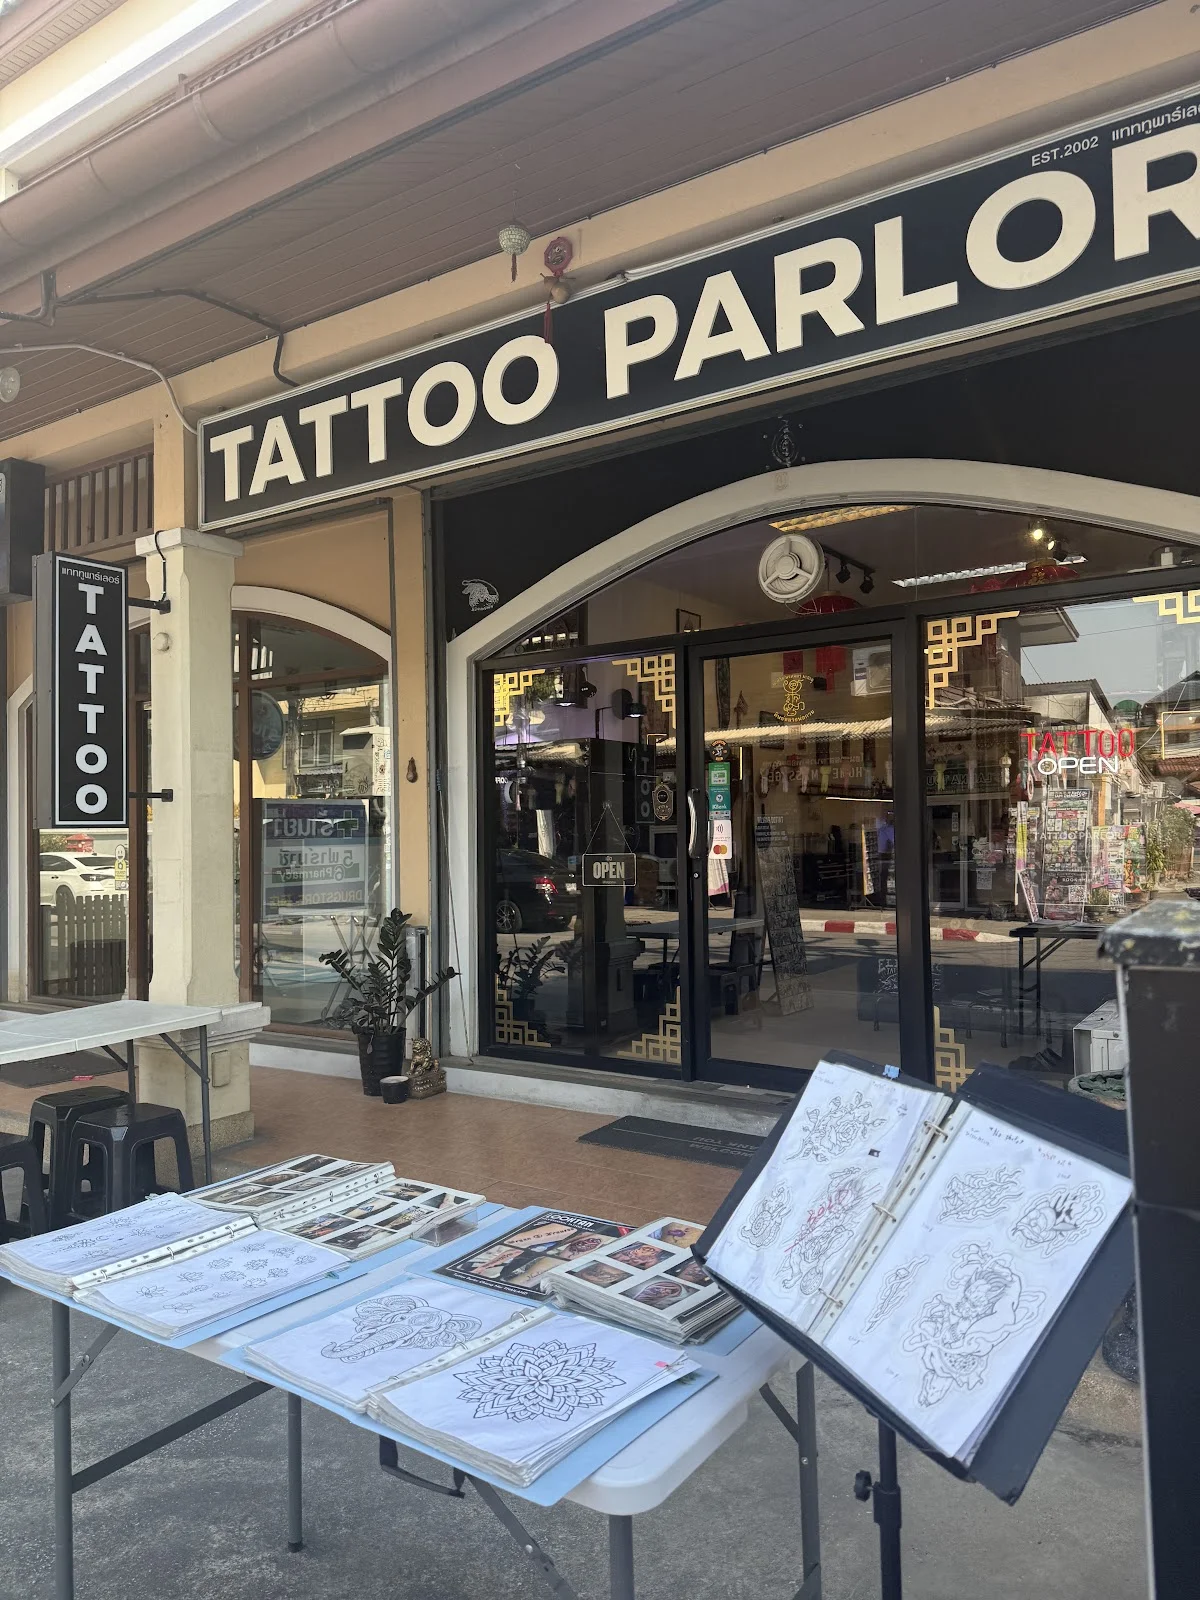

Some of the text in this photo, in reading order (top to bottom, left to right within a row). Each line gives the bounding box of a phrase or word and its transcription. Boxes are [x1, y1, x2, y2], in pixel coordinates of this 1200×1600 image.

[1031, 135, 1099, 167] EST.2002
[209, 124, 1200, 502] TATTOO PARLOR
[74, 583, 108, 814] TATTOO
[1020, 728, 1135, 761] TATTOO
[1037, 756, 1119, 775] OPEN
[592, 861, 625, 879] OPEN
[689, 1143, 755, 1158] WELCOM
